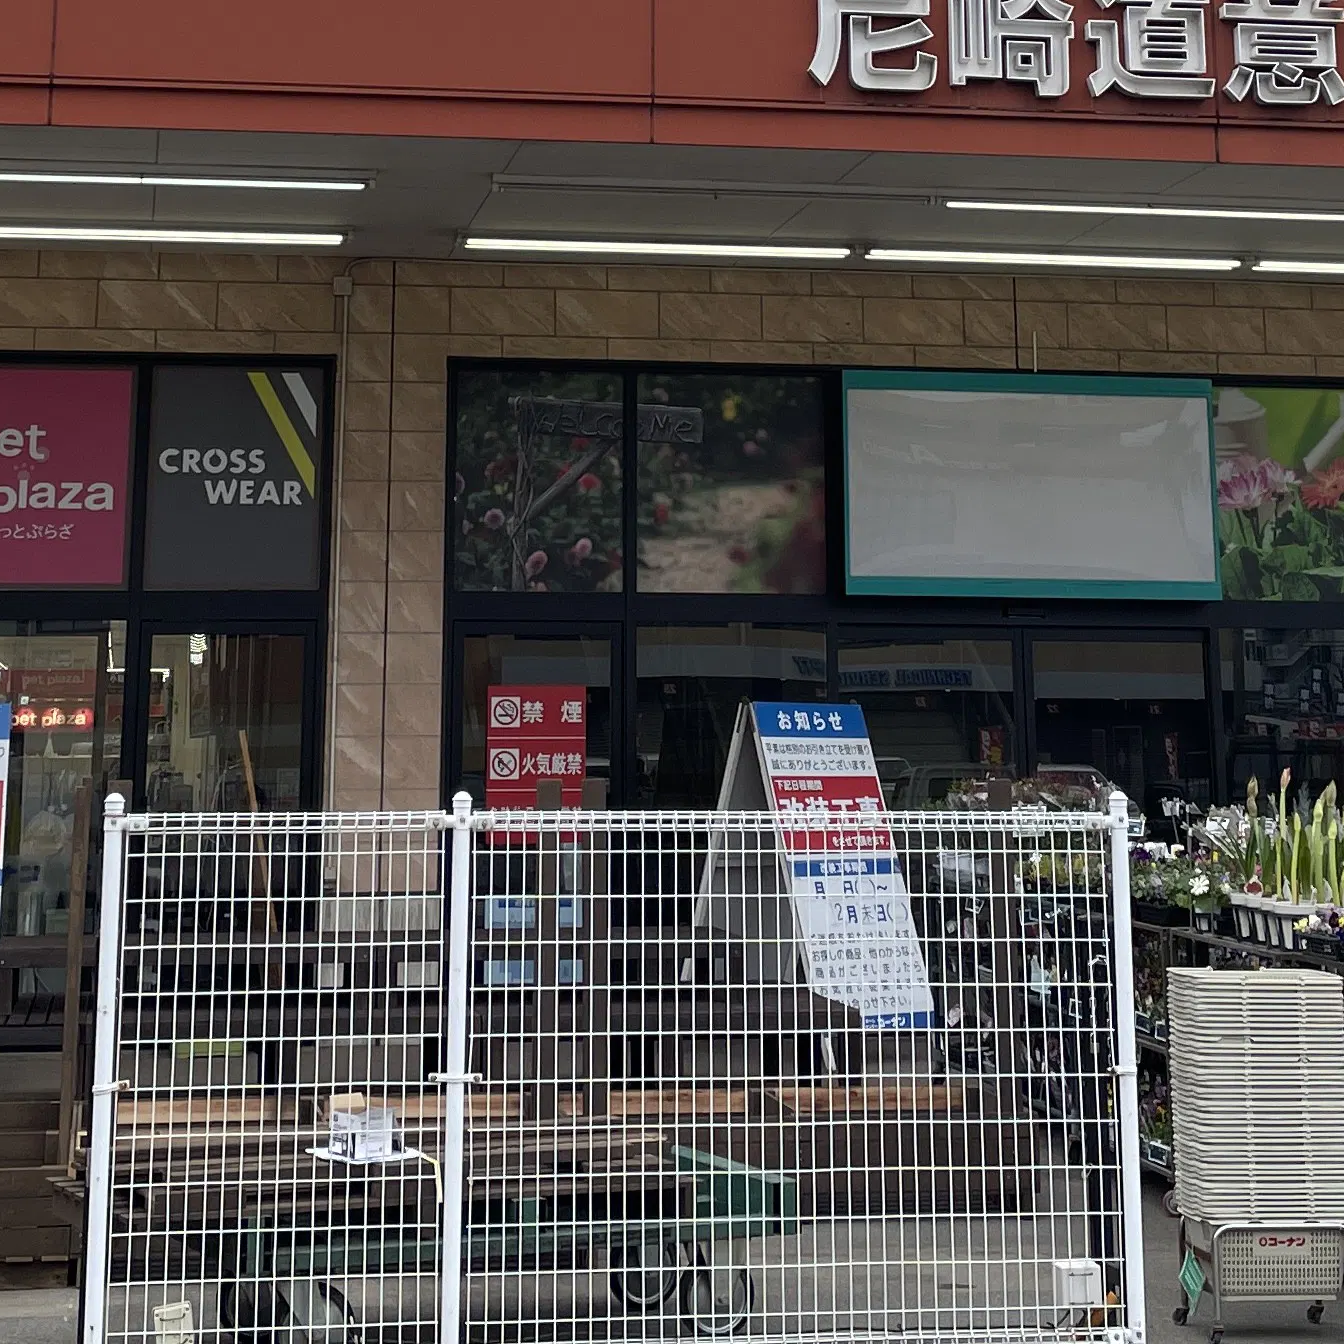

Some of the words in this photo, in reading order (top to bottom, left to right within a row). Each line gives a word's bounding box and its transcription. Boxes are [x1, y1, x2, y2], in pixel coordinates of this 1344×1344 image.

[158, 447, 266, 475] CROSS
[203, 479, 303, 506] WEAR
[776, 710, 844, 732] お知らせ
[520, 752, 583, 776] 火気厳禁
[1268, 1237, 1306, 1247] コーナン
